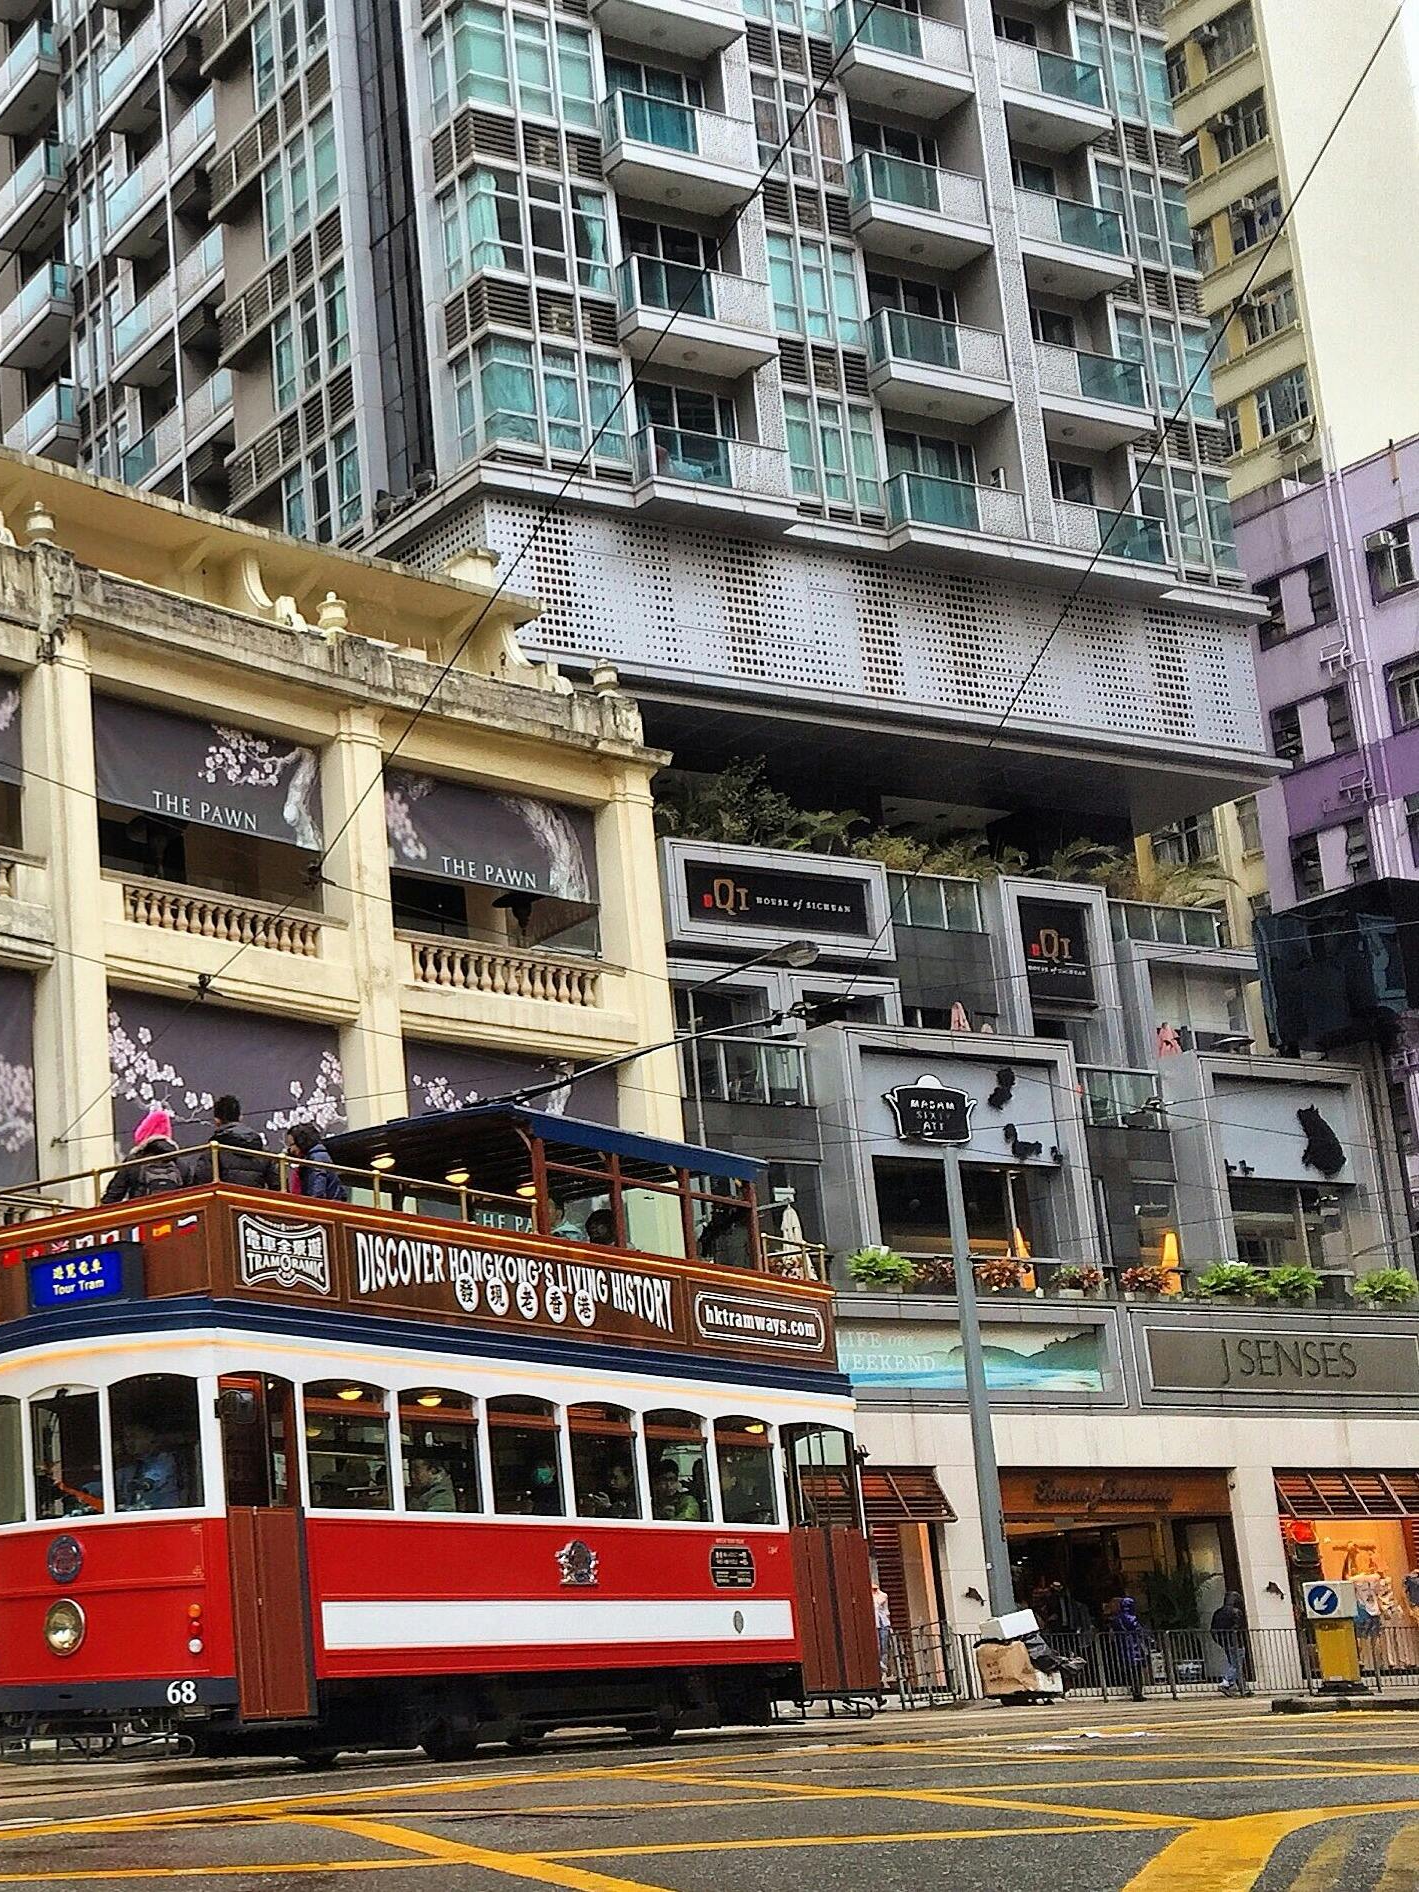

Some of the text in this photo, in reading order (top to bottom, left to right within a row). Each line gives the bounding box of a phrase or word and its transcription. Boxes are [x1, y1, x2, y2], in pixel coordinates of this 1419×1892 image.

[152, 789, 258, 832] THE PAWN
[442, 855, 537, 889] THE PAWN
[792, 898, 804, 911] of
[476, 1212, 506, 1231] HE
[52, 1278, 105, 1297] Tour Tram
[355, 1232, 446, 1295] DISCOVER
[556, 1264, 608, 1305] LIVING
[610, 1271, 675, 1334] HISTORY
[455, 1272, 597, 1328] 發現老香港
[704, 1304, 818, 1338] hktramways.com
[1221, 1338, 1357, 1385] J SENSES
[166, 1680, 198, 1705] 68
